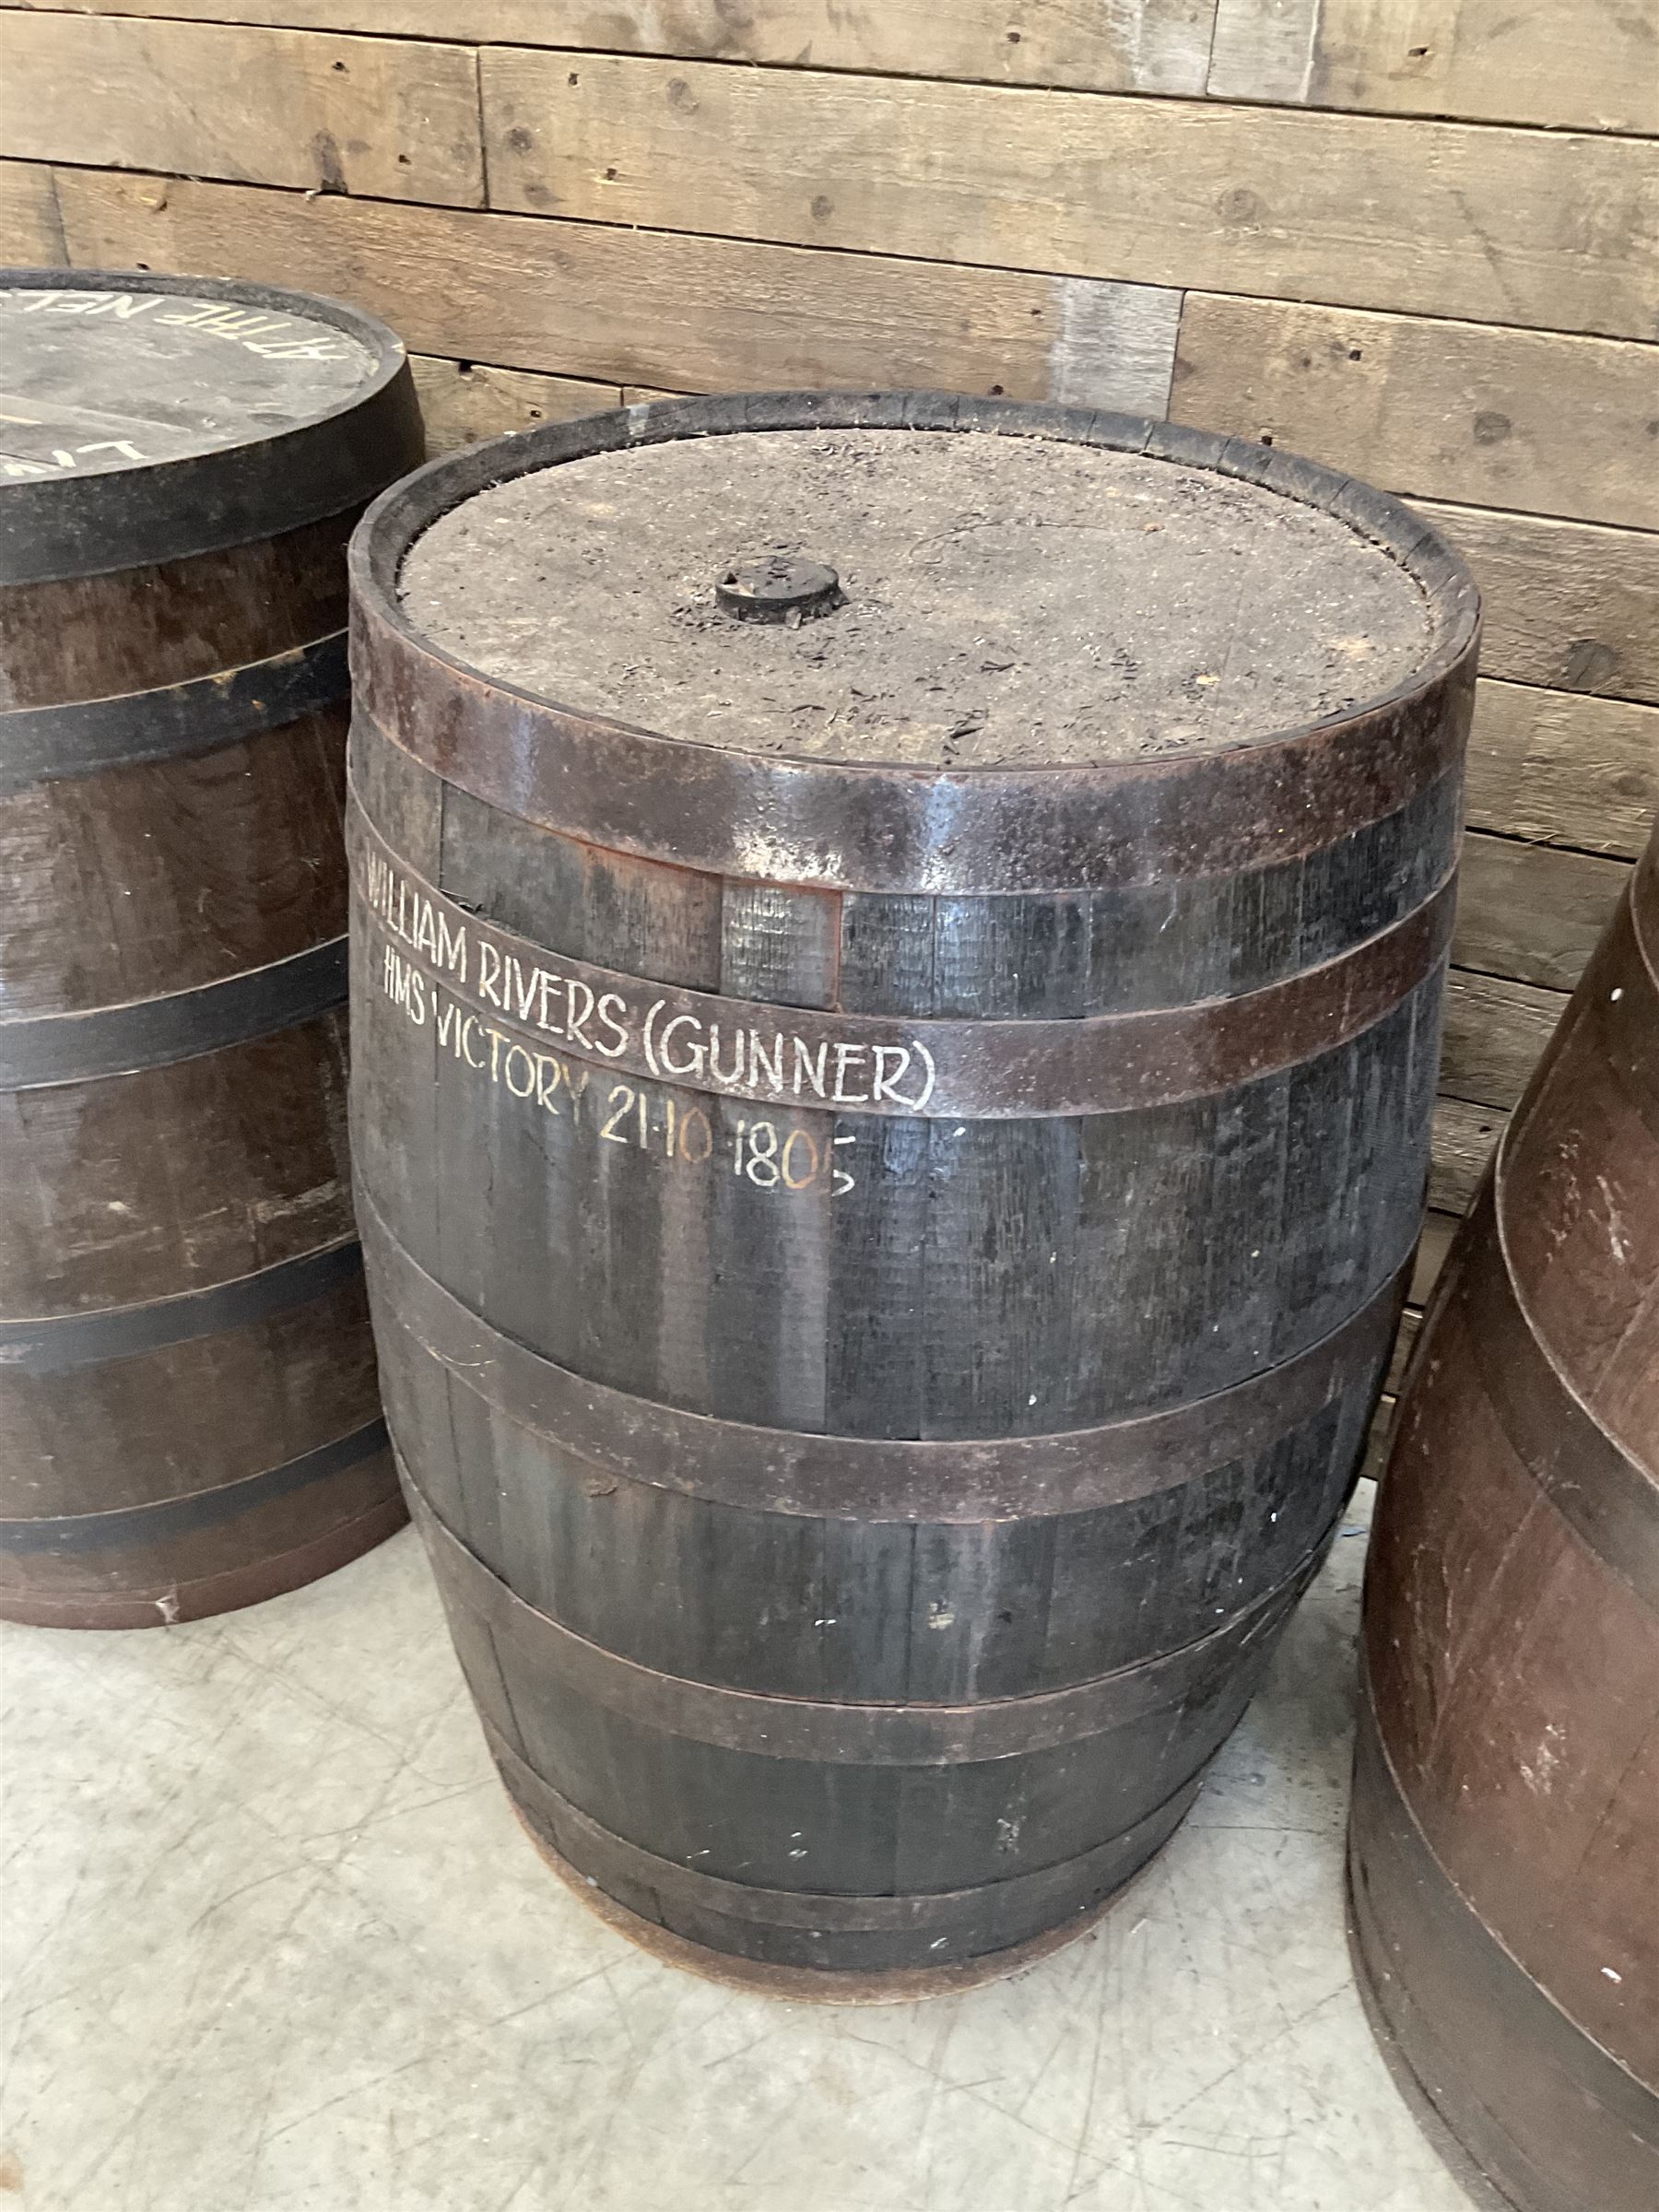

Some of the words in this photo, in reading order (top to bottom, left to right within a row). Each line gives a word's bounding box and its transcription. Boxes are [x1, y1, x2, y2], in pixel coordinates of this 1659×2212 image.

[0, 291, 165, 319] NEL
[153, 302, 292, 340] THE
[242, 336, 349, 359] AT
[366, 842, 467, 983] WILLIAM
[477, 940, 629, 1058] RIVERS
[642, 998, 935, 1112] (GUNNER)
[383, 943, 425, 1025] HMS
[431, 990, 590, 1126] VICTORY
